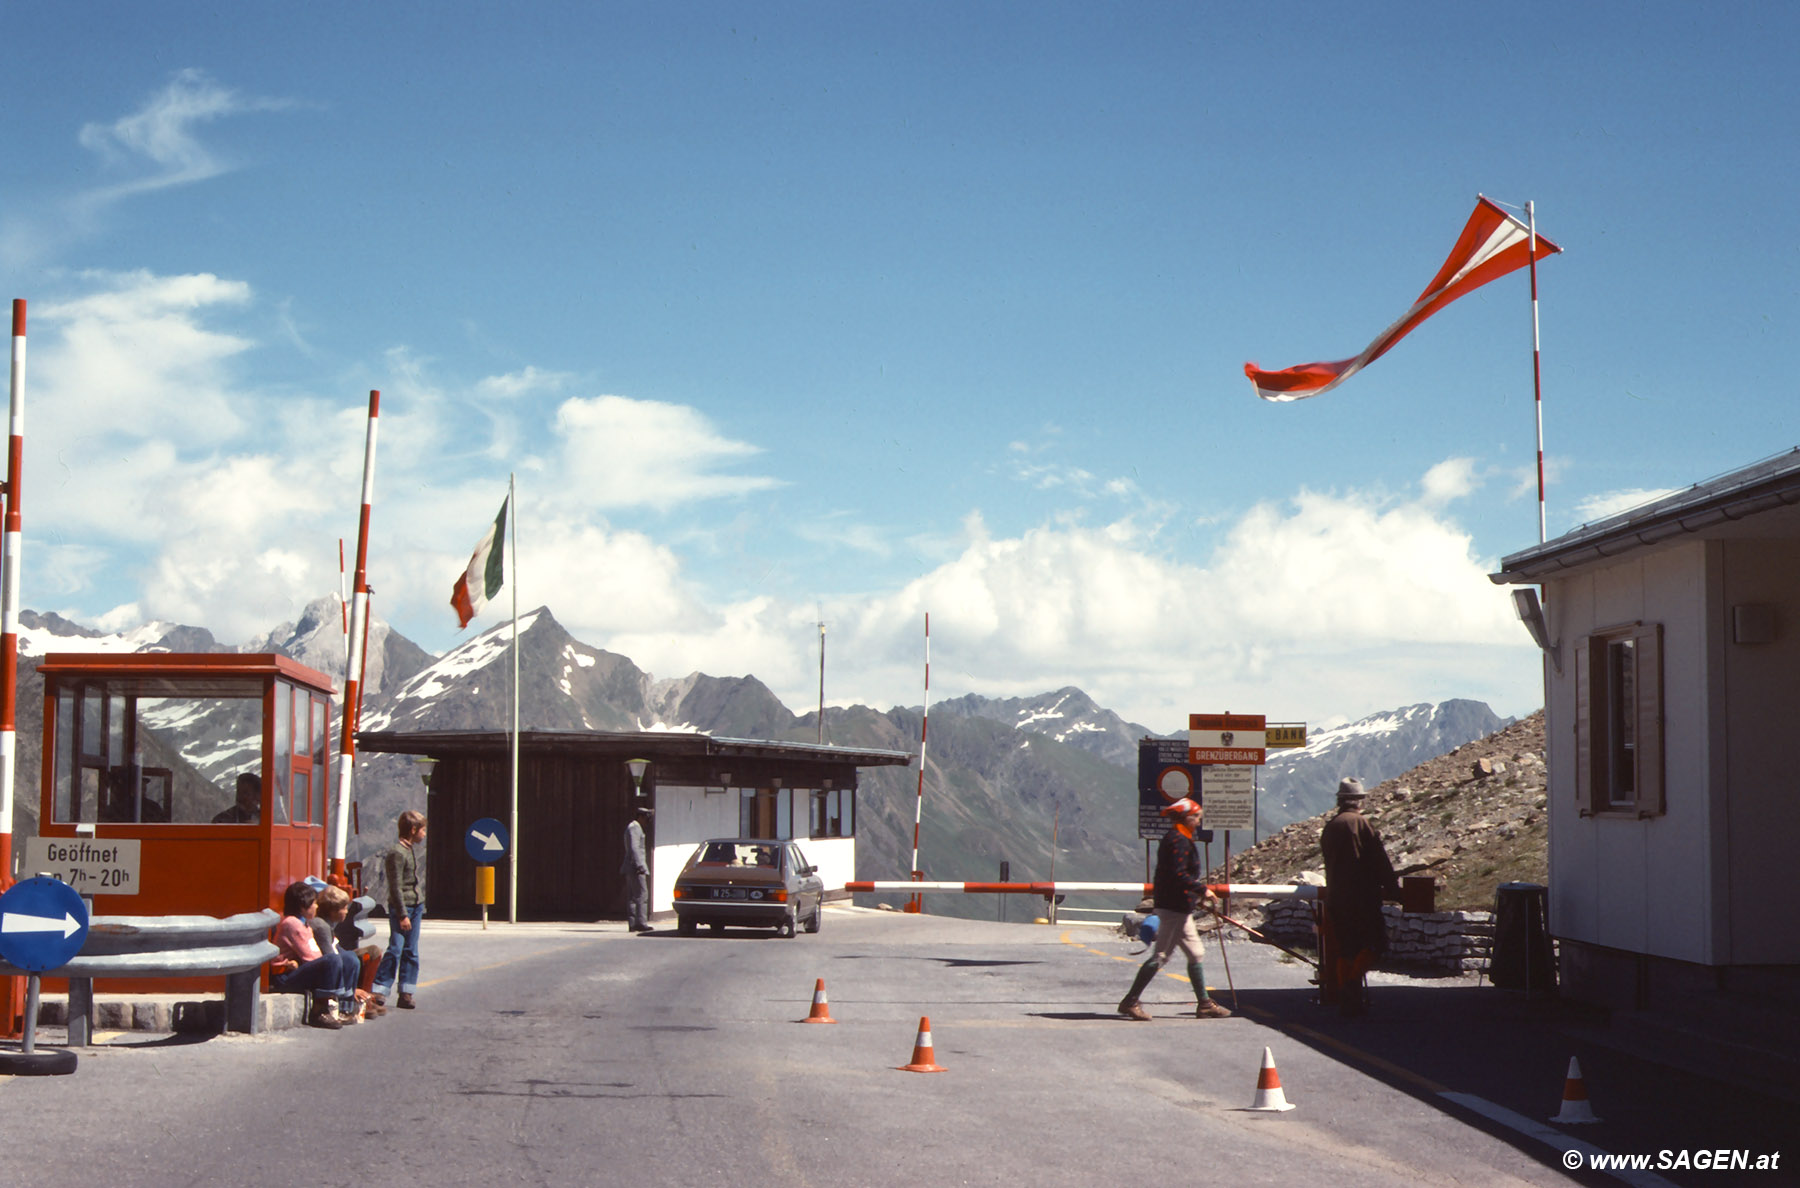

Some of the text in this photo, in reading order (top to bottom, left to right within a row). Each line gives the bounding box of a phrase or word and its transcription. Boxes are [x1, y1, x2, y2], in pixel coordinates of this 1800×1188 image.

[1275, 728, 1304, 741] BANK
[1195, 748, 1259, 762] GRENZÜBERGANG
[47, 842, 118, 863] Geöffnet
